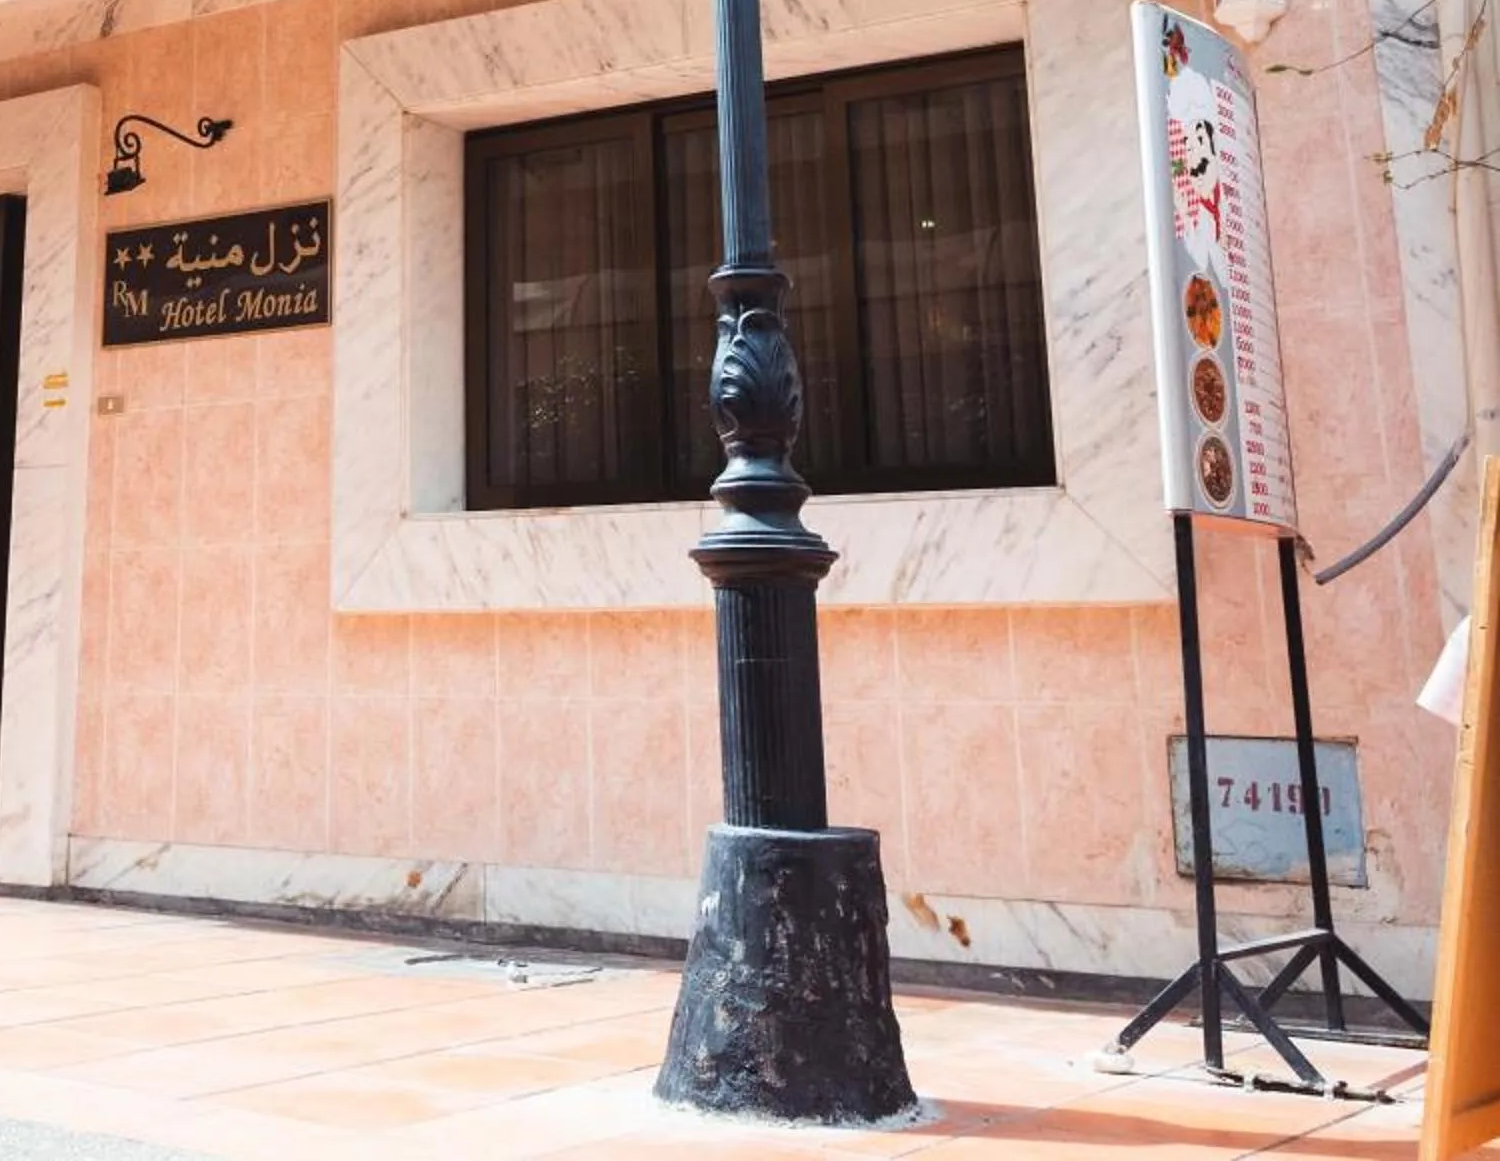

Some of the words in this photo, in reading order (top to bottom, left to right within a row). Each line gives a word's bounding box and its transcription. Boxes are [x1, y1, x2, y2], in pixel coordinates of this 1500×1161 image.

[165, 230, 245, 288] منية
[250, 215, 321, 276] نزل
[159, 288, 231, 332] Hotel
[235, 283, 318, 322] Monia
